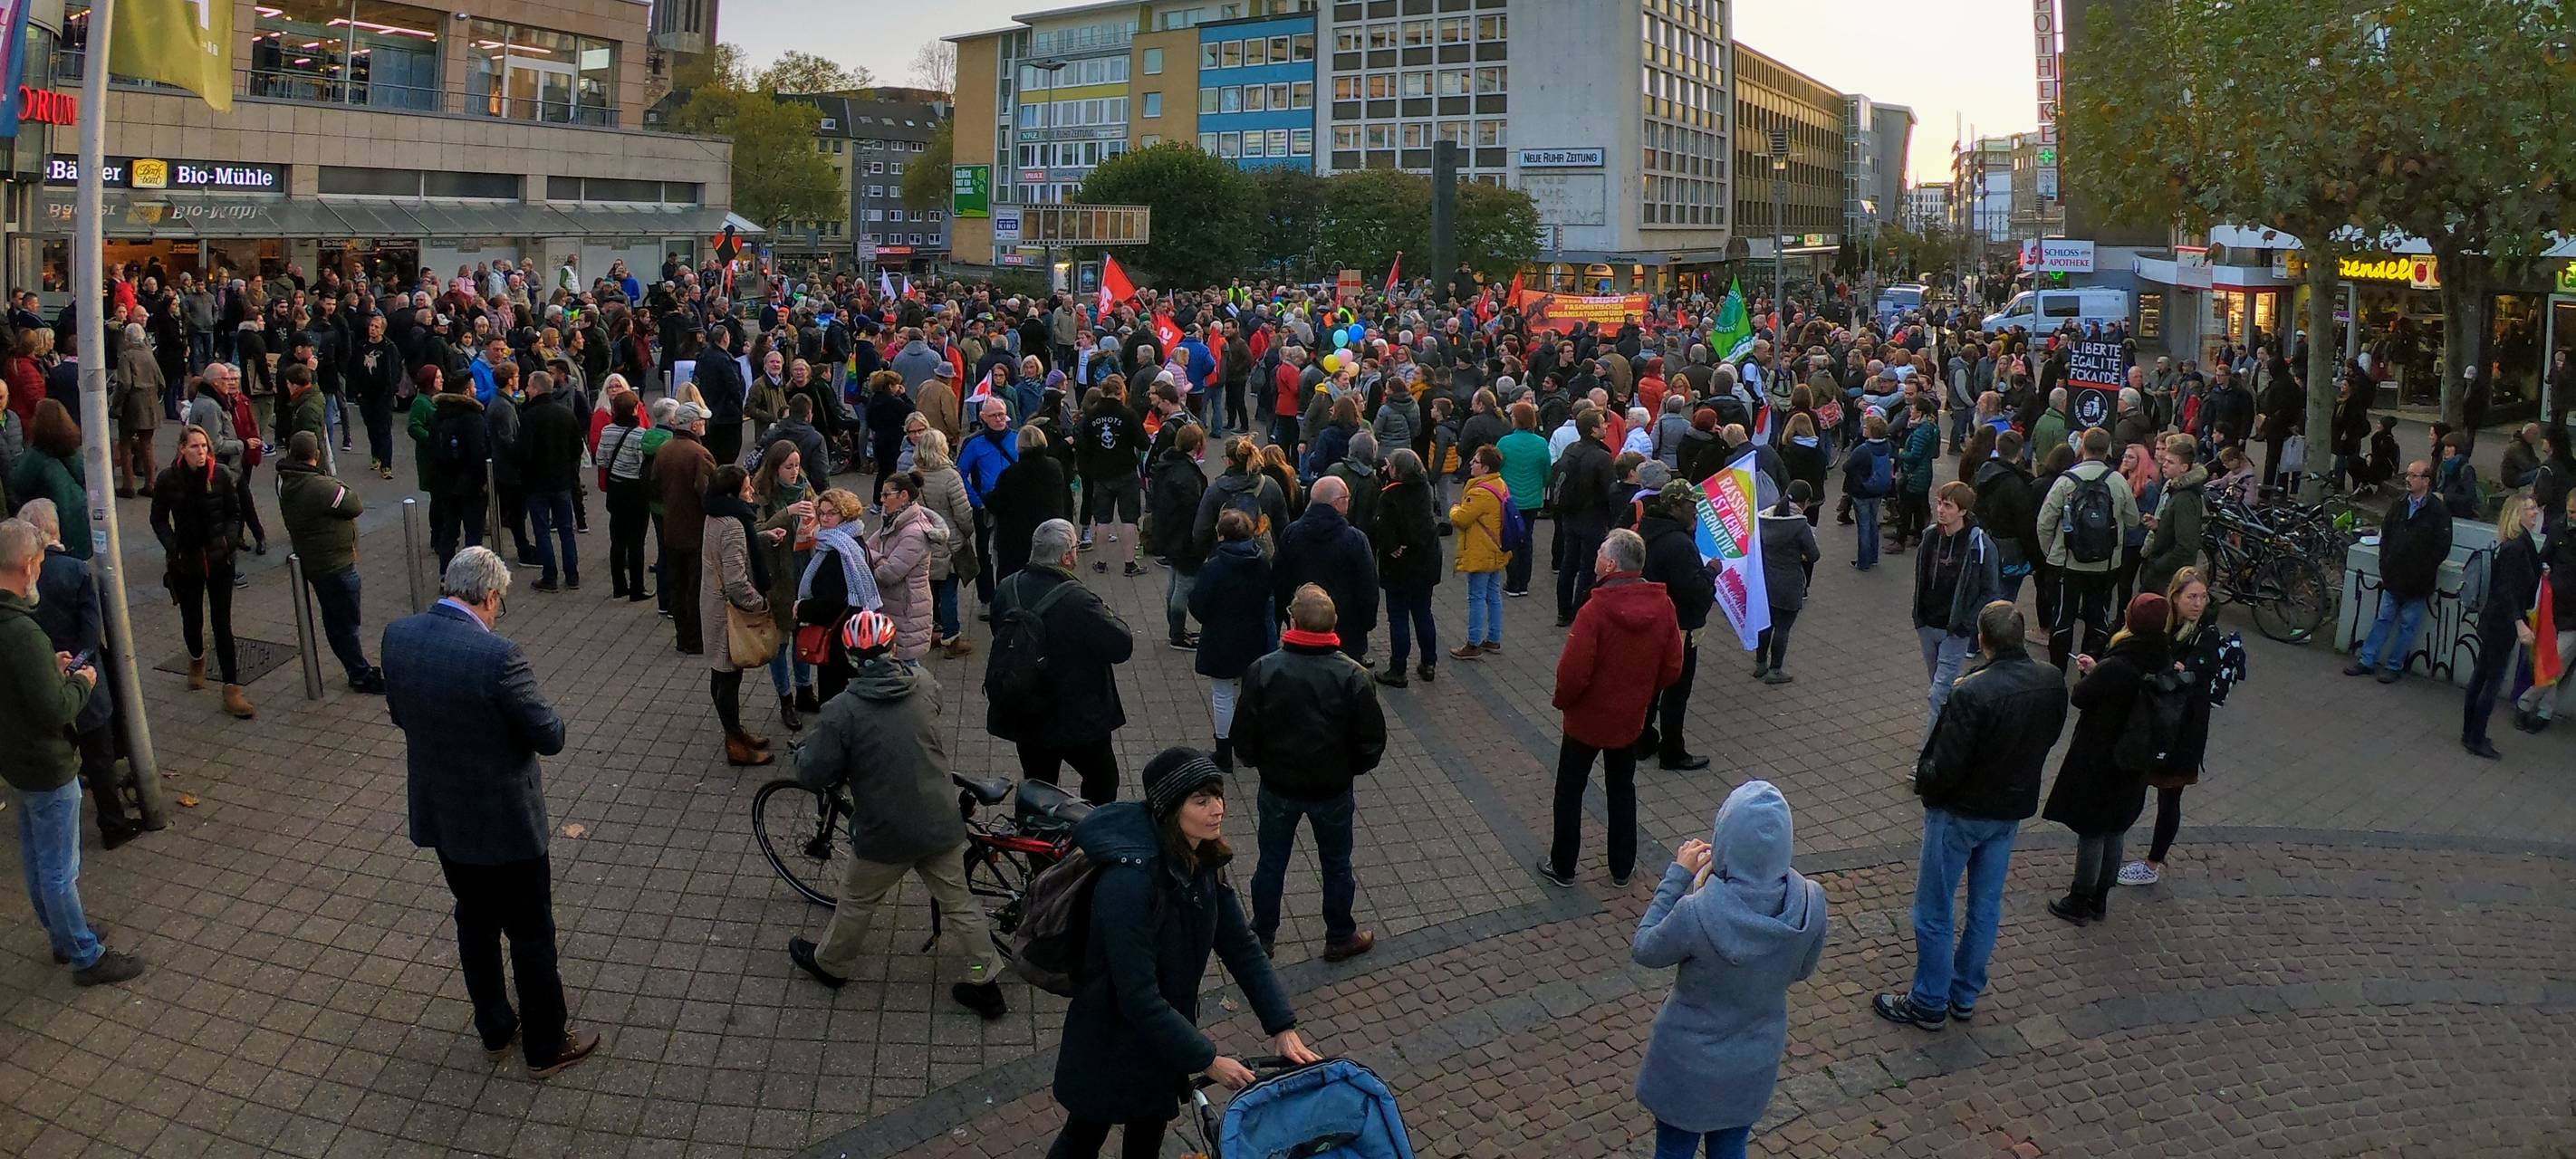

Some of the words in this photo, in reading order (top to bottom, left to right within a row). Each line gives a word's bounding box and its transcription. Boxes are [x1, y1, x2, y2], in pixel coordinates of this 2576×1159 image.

[1523, 153, 1542, 163] NEUE
[1543, 153, 1563, 163] RUHR
[1566, 152, 1597, 163] ZEITUNG
[51, 160, 122, 180] Bäer
[177, 166, 273, 186] Bio-Mühle
[2044, 248, 2080, 257] SCHLOSS
[2049, 258, 2091, 267] APOTHEKE
[1091, 417, 1122, 427] DONOTS
[1719, 475, 1750, 532] RASSISM
[1696, 498, 1738, 557] LTERNATIVE
[1711, 494, 1725, 515] IST
[1722, 512, 1746, 542] KEINE
